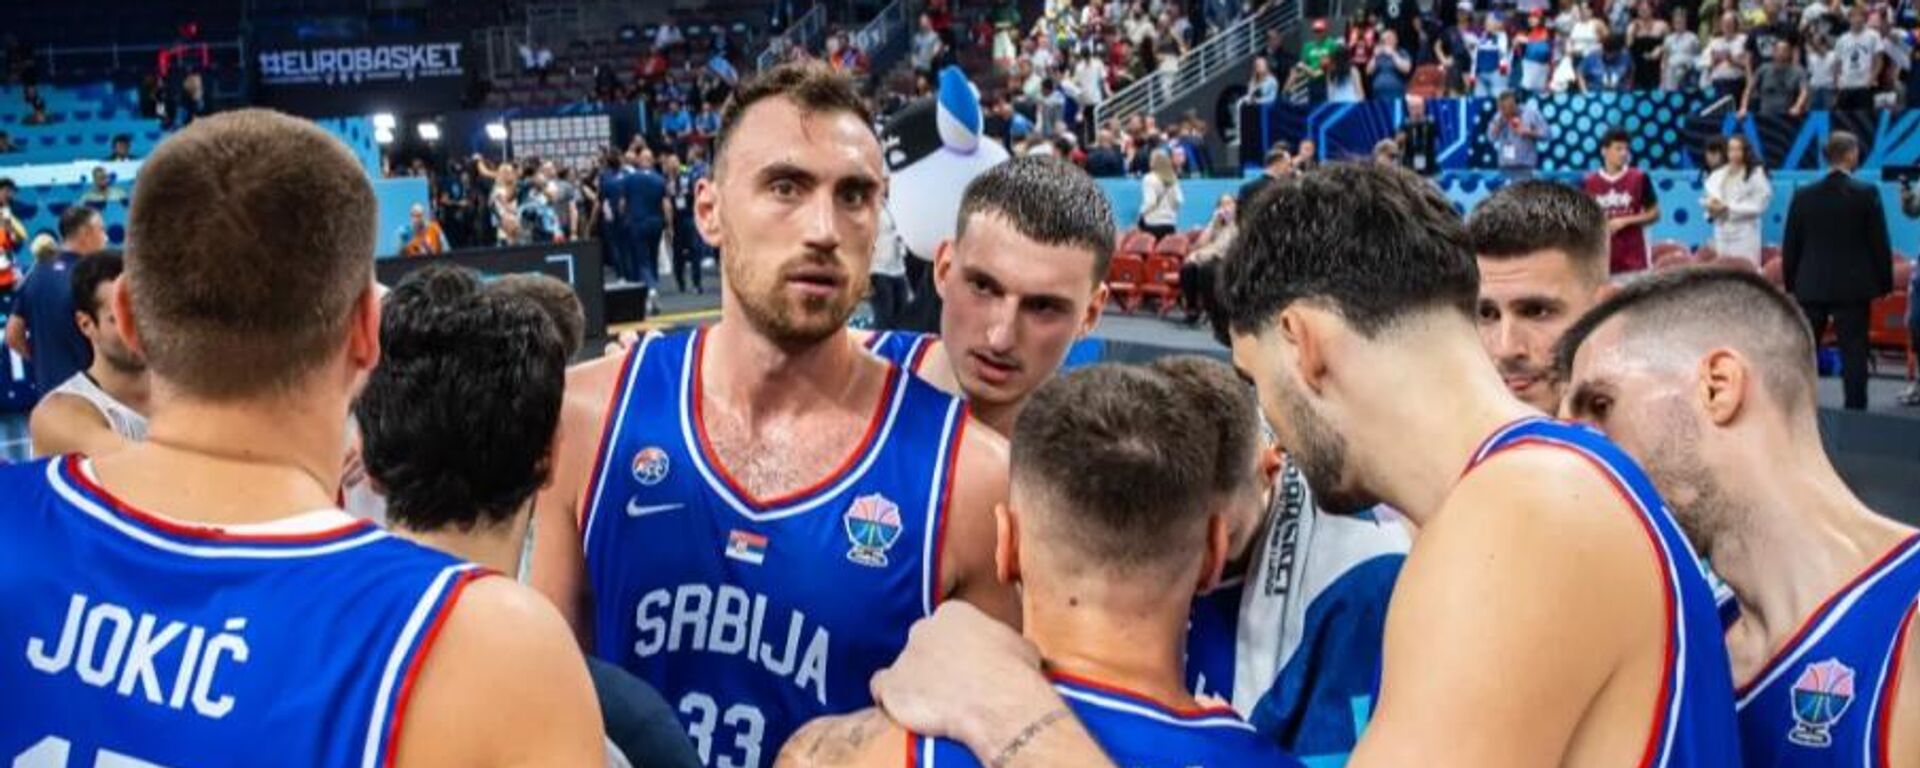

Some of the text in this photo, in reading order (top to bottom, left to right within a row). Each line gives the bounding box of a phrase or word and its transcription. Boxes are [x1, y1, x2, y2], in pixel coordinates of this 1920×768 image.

[260, 42, 462, 75] #EUROBASKET
[26, 593, 249, 719] JOKIĆ
[634, 583, 829, 706] SRBIJA
[679, 691, 766, 768] 33
